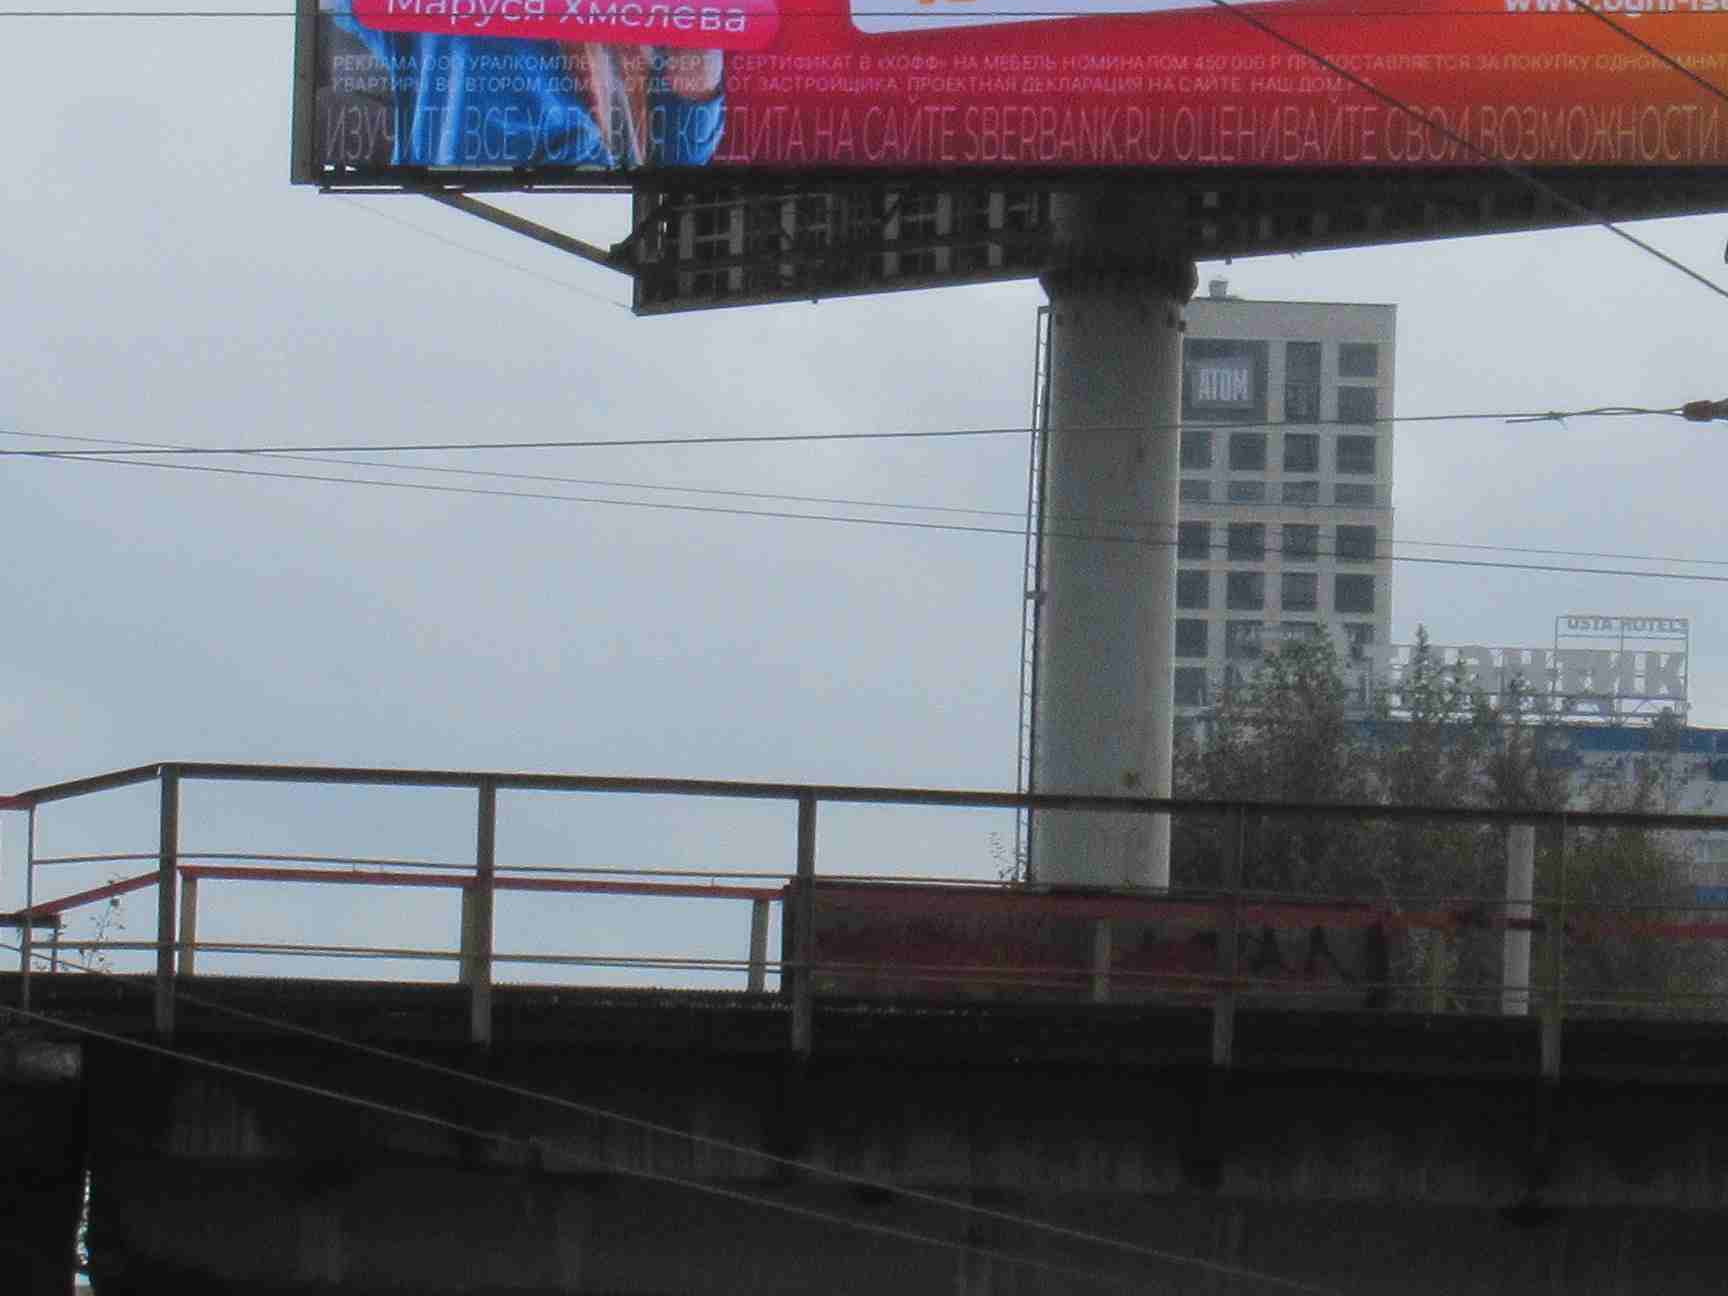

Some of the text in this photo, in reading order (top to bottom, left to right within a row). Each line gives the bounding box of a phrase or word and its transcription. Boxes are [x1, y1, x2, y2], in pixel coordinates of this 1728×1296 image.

[732, 54, 852, 72] СЕРТИФИКАТ
[953, 54, 978, 72] НА
[984, 54, 1057, 72] МЕБЕЛЬ
[547, 76, 601, 93] ДОМ
[622, 76, 719, 93] ОТДЕЛКО
[1147, 76, 1176, 93] НА
[464, 106, 520, 161] ВСЕ
[816, 106, 856, 161] НА
[862, 98, 960, 161] САЙТЕ
[1173, 98, 1378, 163] ОЦЕНИВАЙТЕ
[1384, 106, 1470, 161] СВОИ
[1479, 106, 1718, 161] ВОЗМОЖНОСТИ
